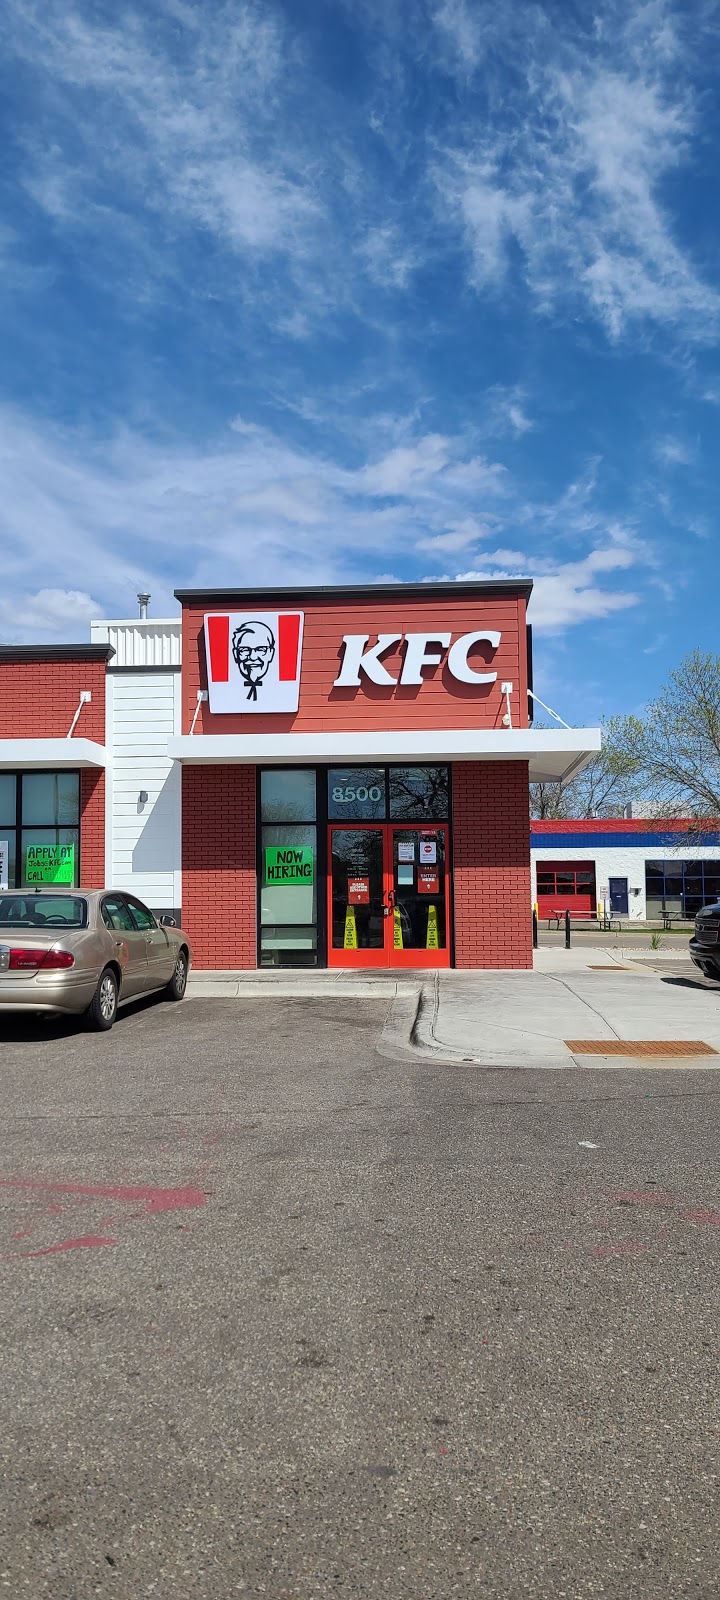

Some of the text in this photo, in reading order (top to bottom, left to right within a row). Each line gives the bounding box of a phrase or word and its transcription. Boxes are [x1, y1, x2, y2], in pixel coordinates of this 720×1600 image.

[333, 630, 502, 686] KFC
[332, 786, 381, 802] 8500
[28, 847, 72, 859] APPLY AT
[276, 850, 304, 864] NOW
[28, 871, 43, 880] CALL
[267, 863, 312, 880] HIRING
